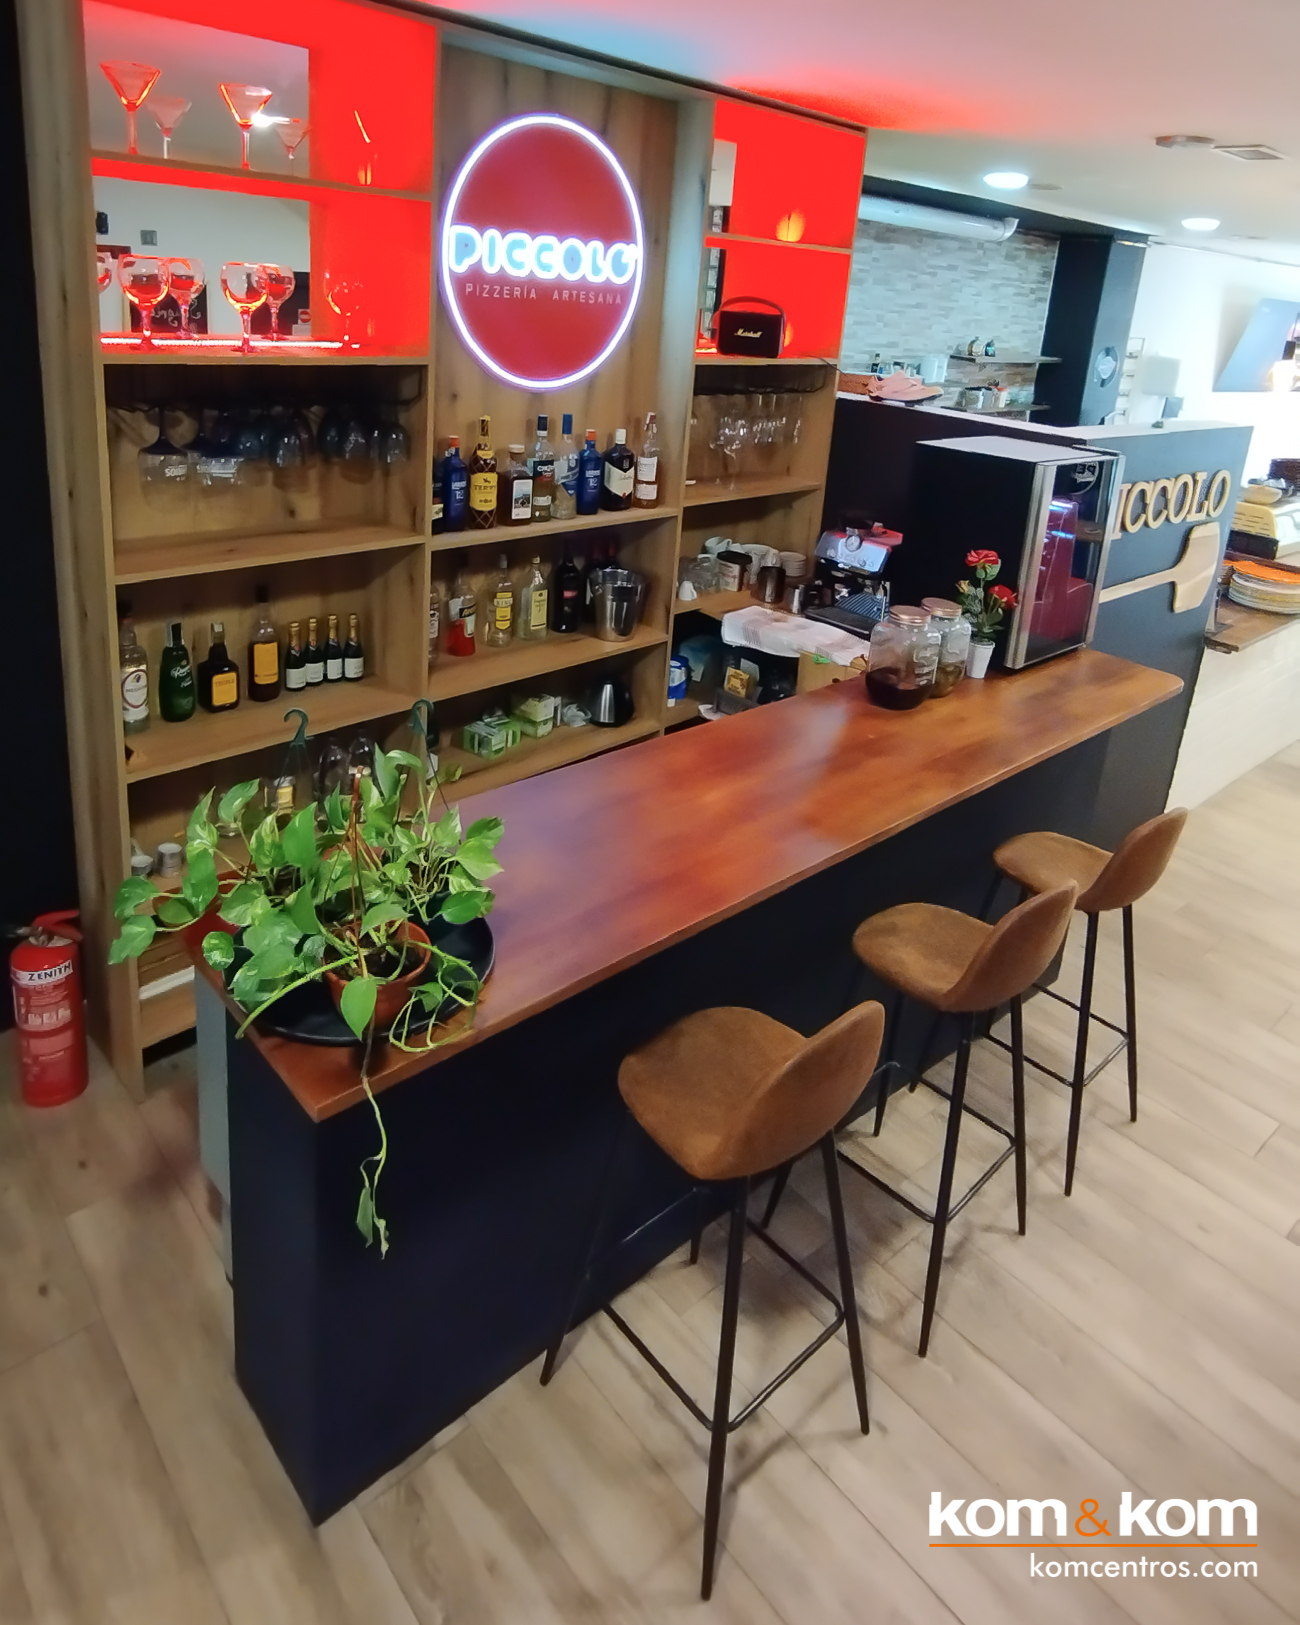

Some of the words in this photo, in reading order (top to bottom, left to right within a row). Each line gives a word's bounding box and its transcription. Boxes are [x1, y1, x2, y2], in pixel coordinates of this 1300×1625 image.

[450, 225, 637, 285] PICCOLO
[465, 283, 536, 300] PIZZERÍA
[552, 289, 622, 305] ARTESANA
[1111, 469, 1231, 541] ICCOLO
[27, 961, 72, 982] ZENITH
